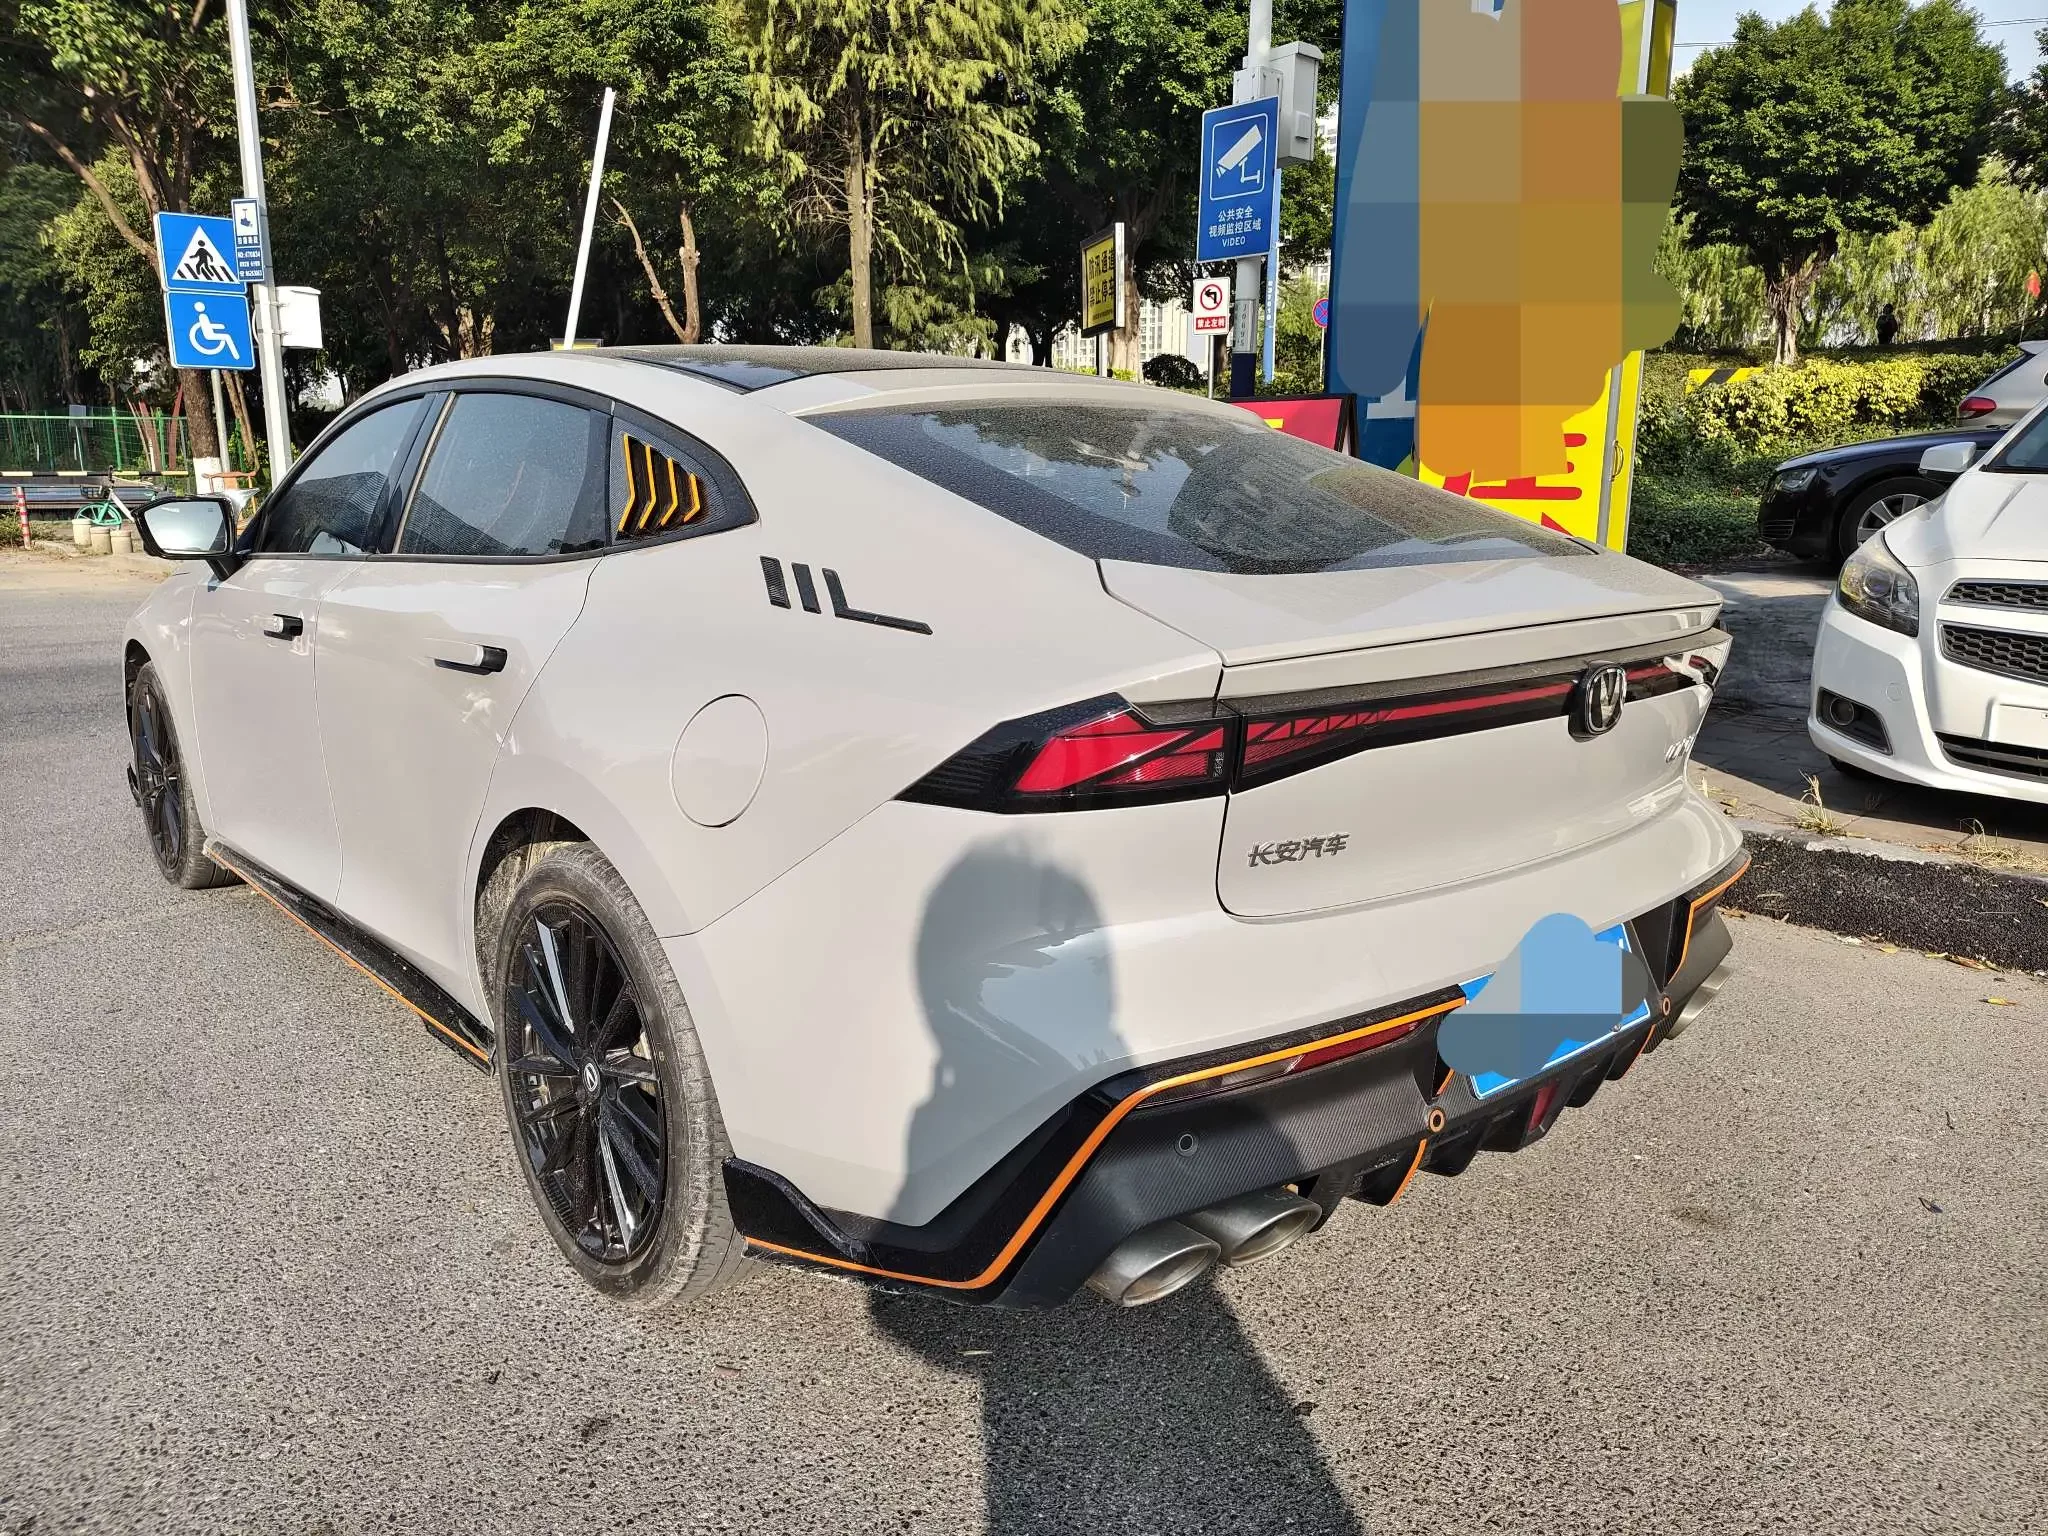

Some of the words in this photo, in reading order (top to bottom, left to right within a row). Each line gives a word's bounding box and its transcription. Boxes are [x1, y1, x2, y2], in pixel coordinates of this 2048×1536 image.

[1218, 205, 1254, 222] 公共安全
[1208, 217, 1262, 238] 视频监控区域
[1221, 235, 1246, 248] VIDEO
[1089, 276, 1115, 307] 禁止停车
[1247, 833, 1350, 867] 长安汽车
